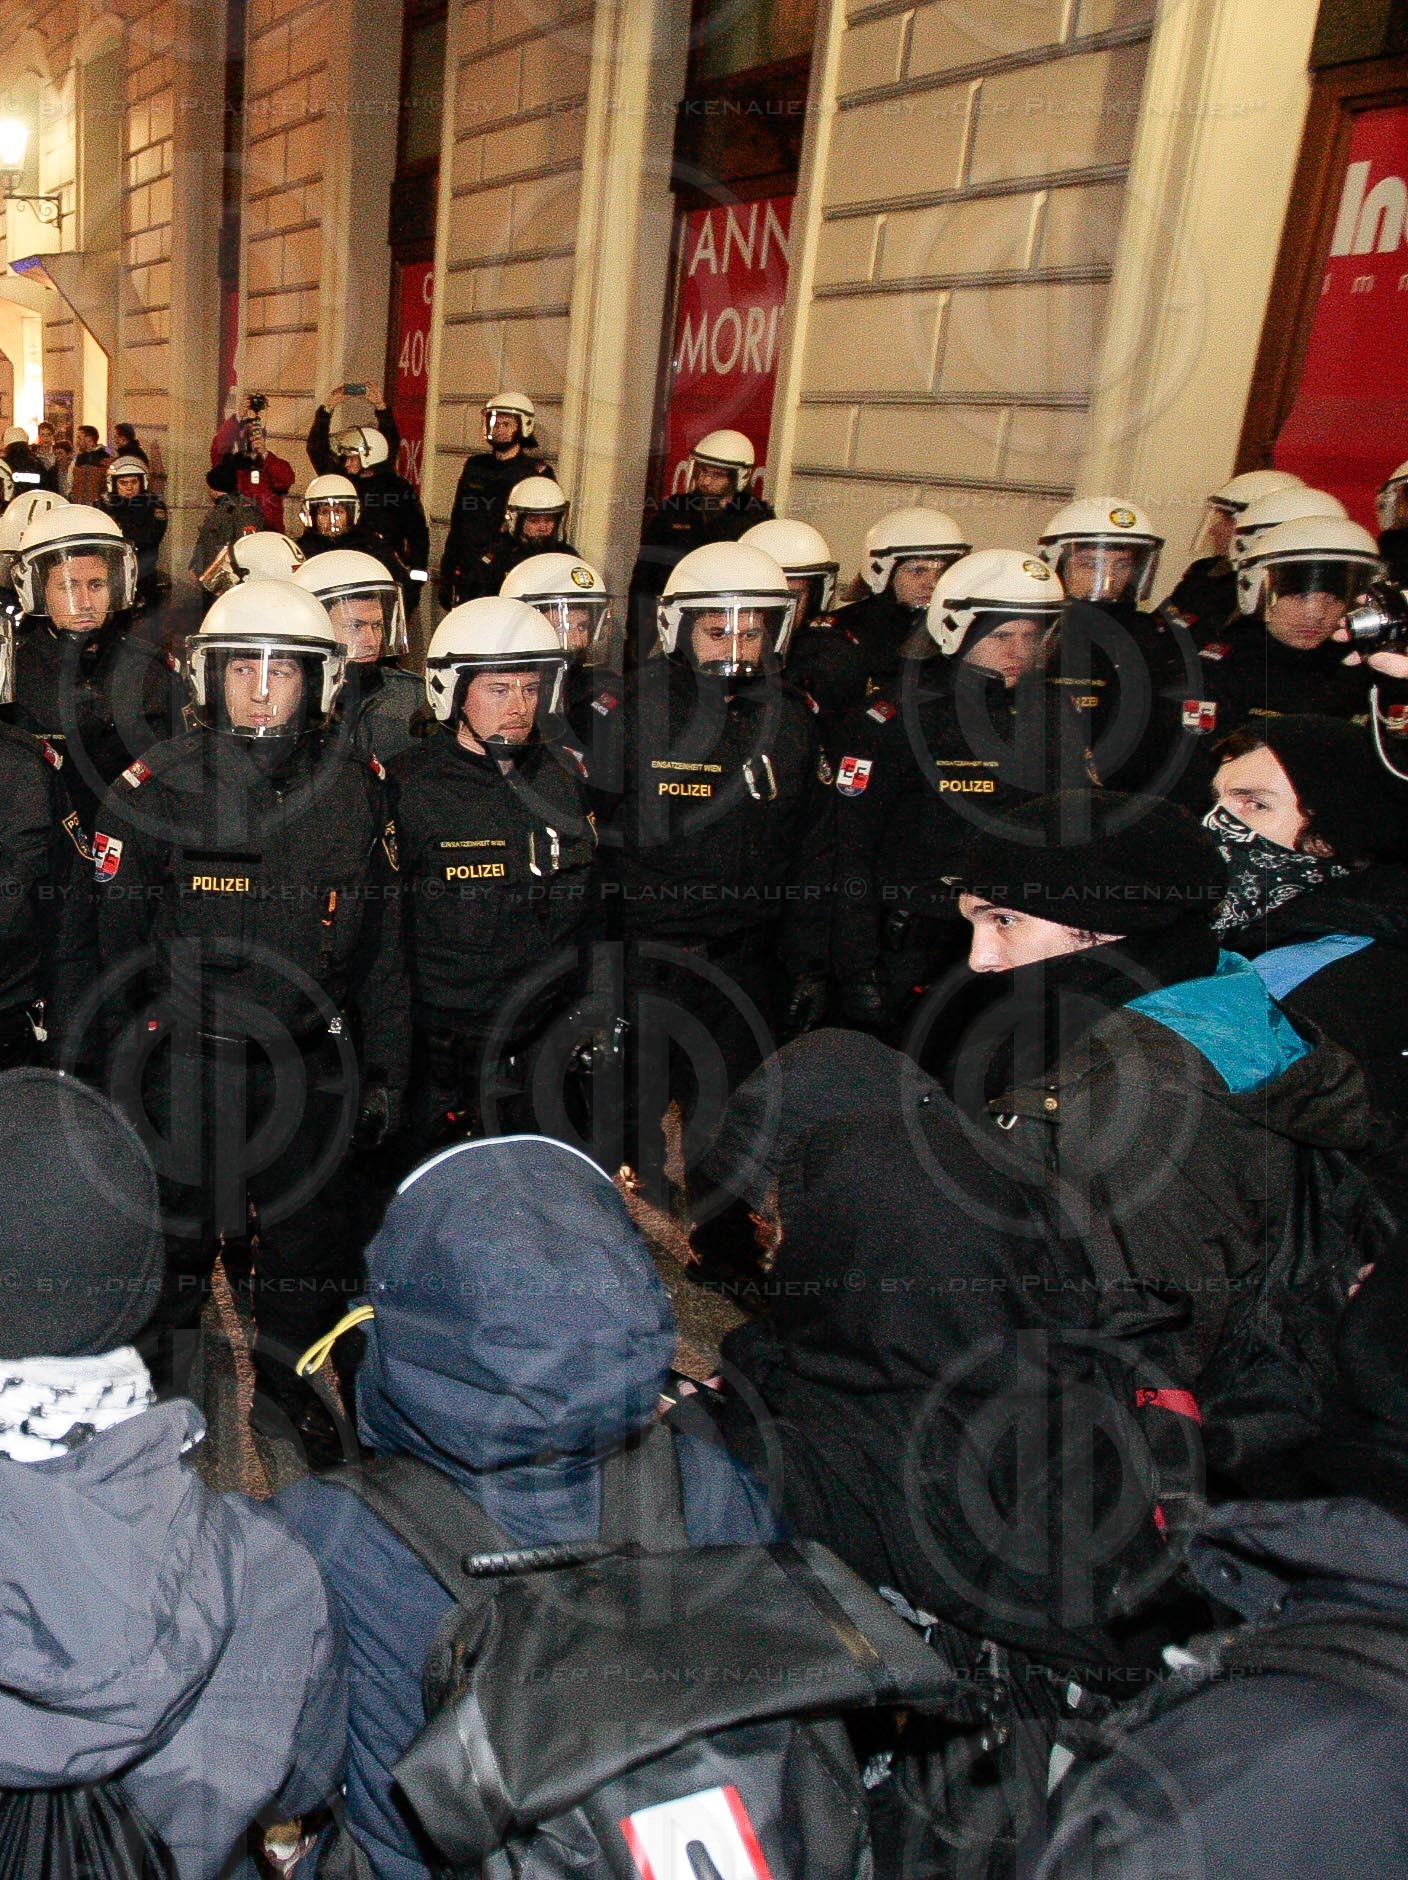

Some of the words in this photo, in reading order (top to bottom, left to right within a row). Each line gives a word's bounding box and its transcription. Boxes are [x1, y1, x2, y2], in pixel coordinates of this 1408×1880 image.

[1329, 160, 1408, 257] In
[675, 305, 783, 374] MORI
[658, 783, 711, 797] POLIZEI
[939, 780, 994, 793] POLIZEI
[446, 863, 505, 880] POLIZEI
[192, 876, 250, 892] POLIZEI
